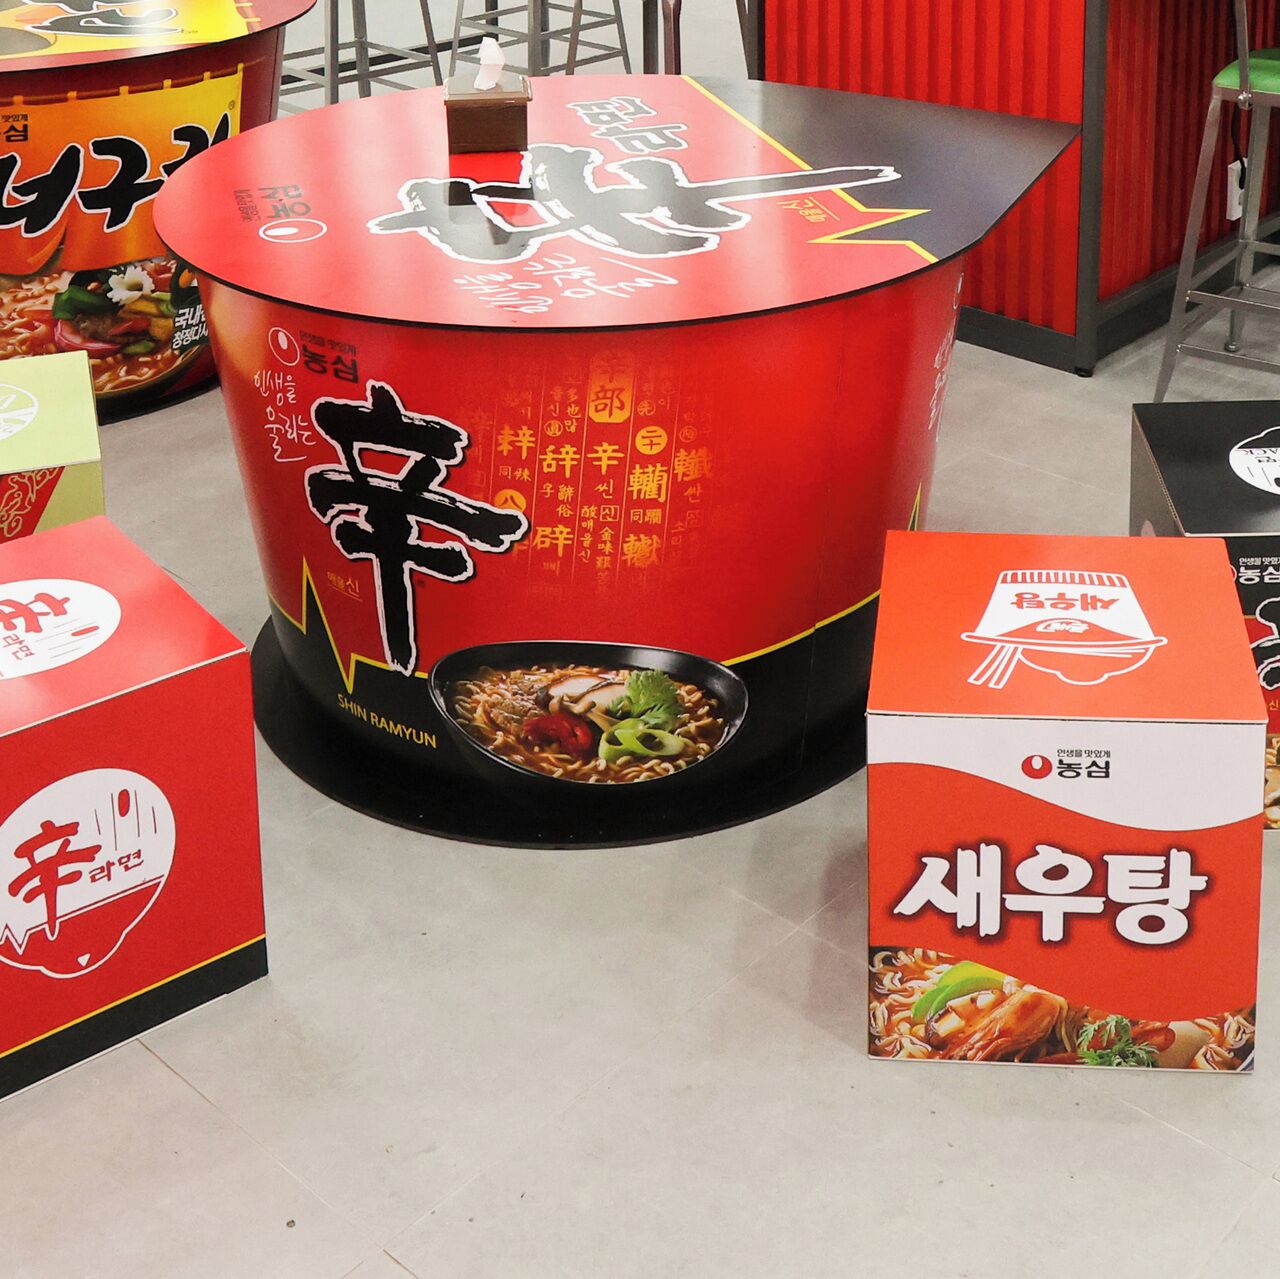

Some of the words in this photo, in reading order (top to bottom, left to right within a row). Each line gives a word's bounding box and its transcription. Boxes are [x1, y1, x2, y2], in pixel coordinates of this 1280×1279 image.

[302, 343, 359, 384] 농심
[305, 380, 528, 677] 辛
[1011, 591, 1119, 612] 새우탕
[337, 692, 368, 723] SHIN
[370, 710, 438, 750] RAMYUN
[1057, 749, 1083, 758] 인생을
[1084, 749, 1111, 759] 맛있게
[1057, 758, 1111, 779] 농심
[8, 818, 102, 941] 辛
[87, 847, 145, 886] 라면
[894, 842, 1209, 945] 새우탕
